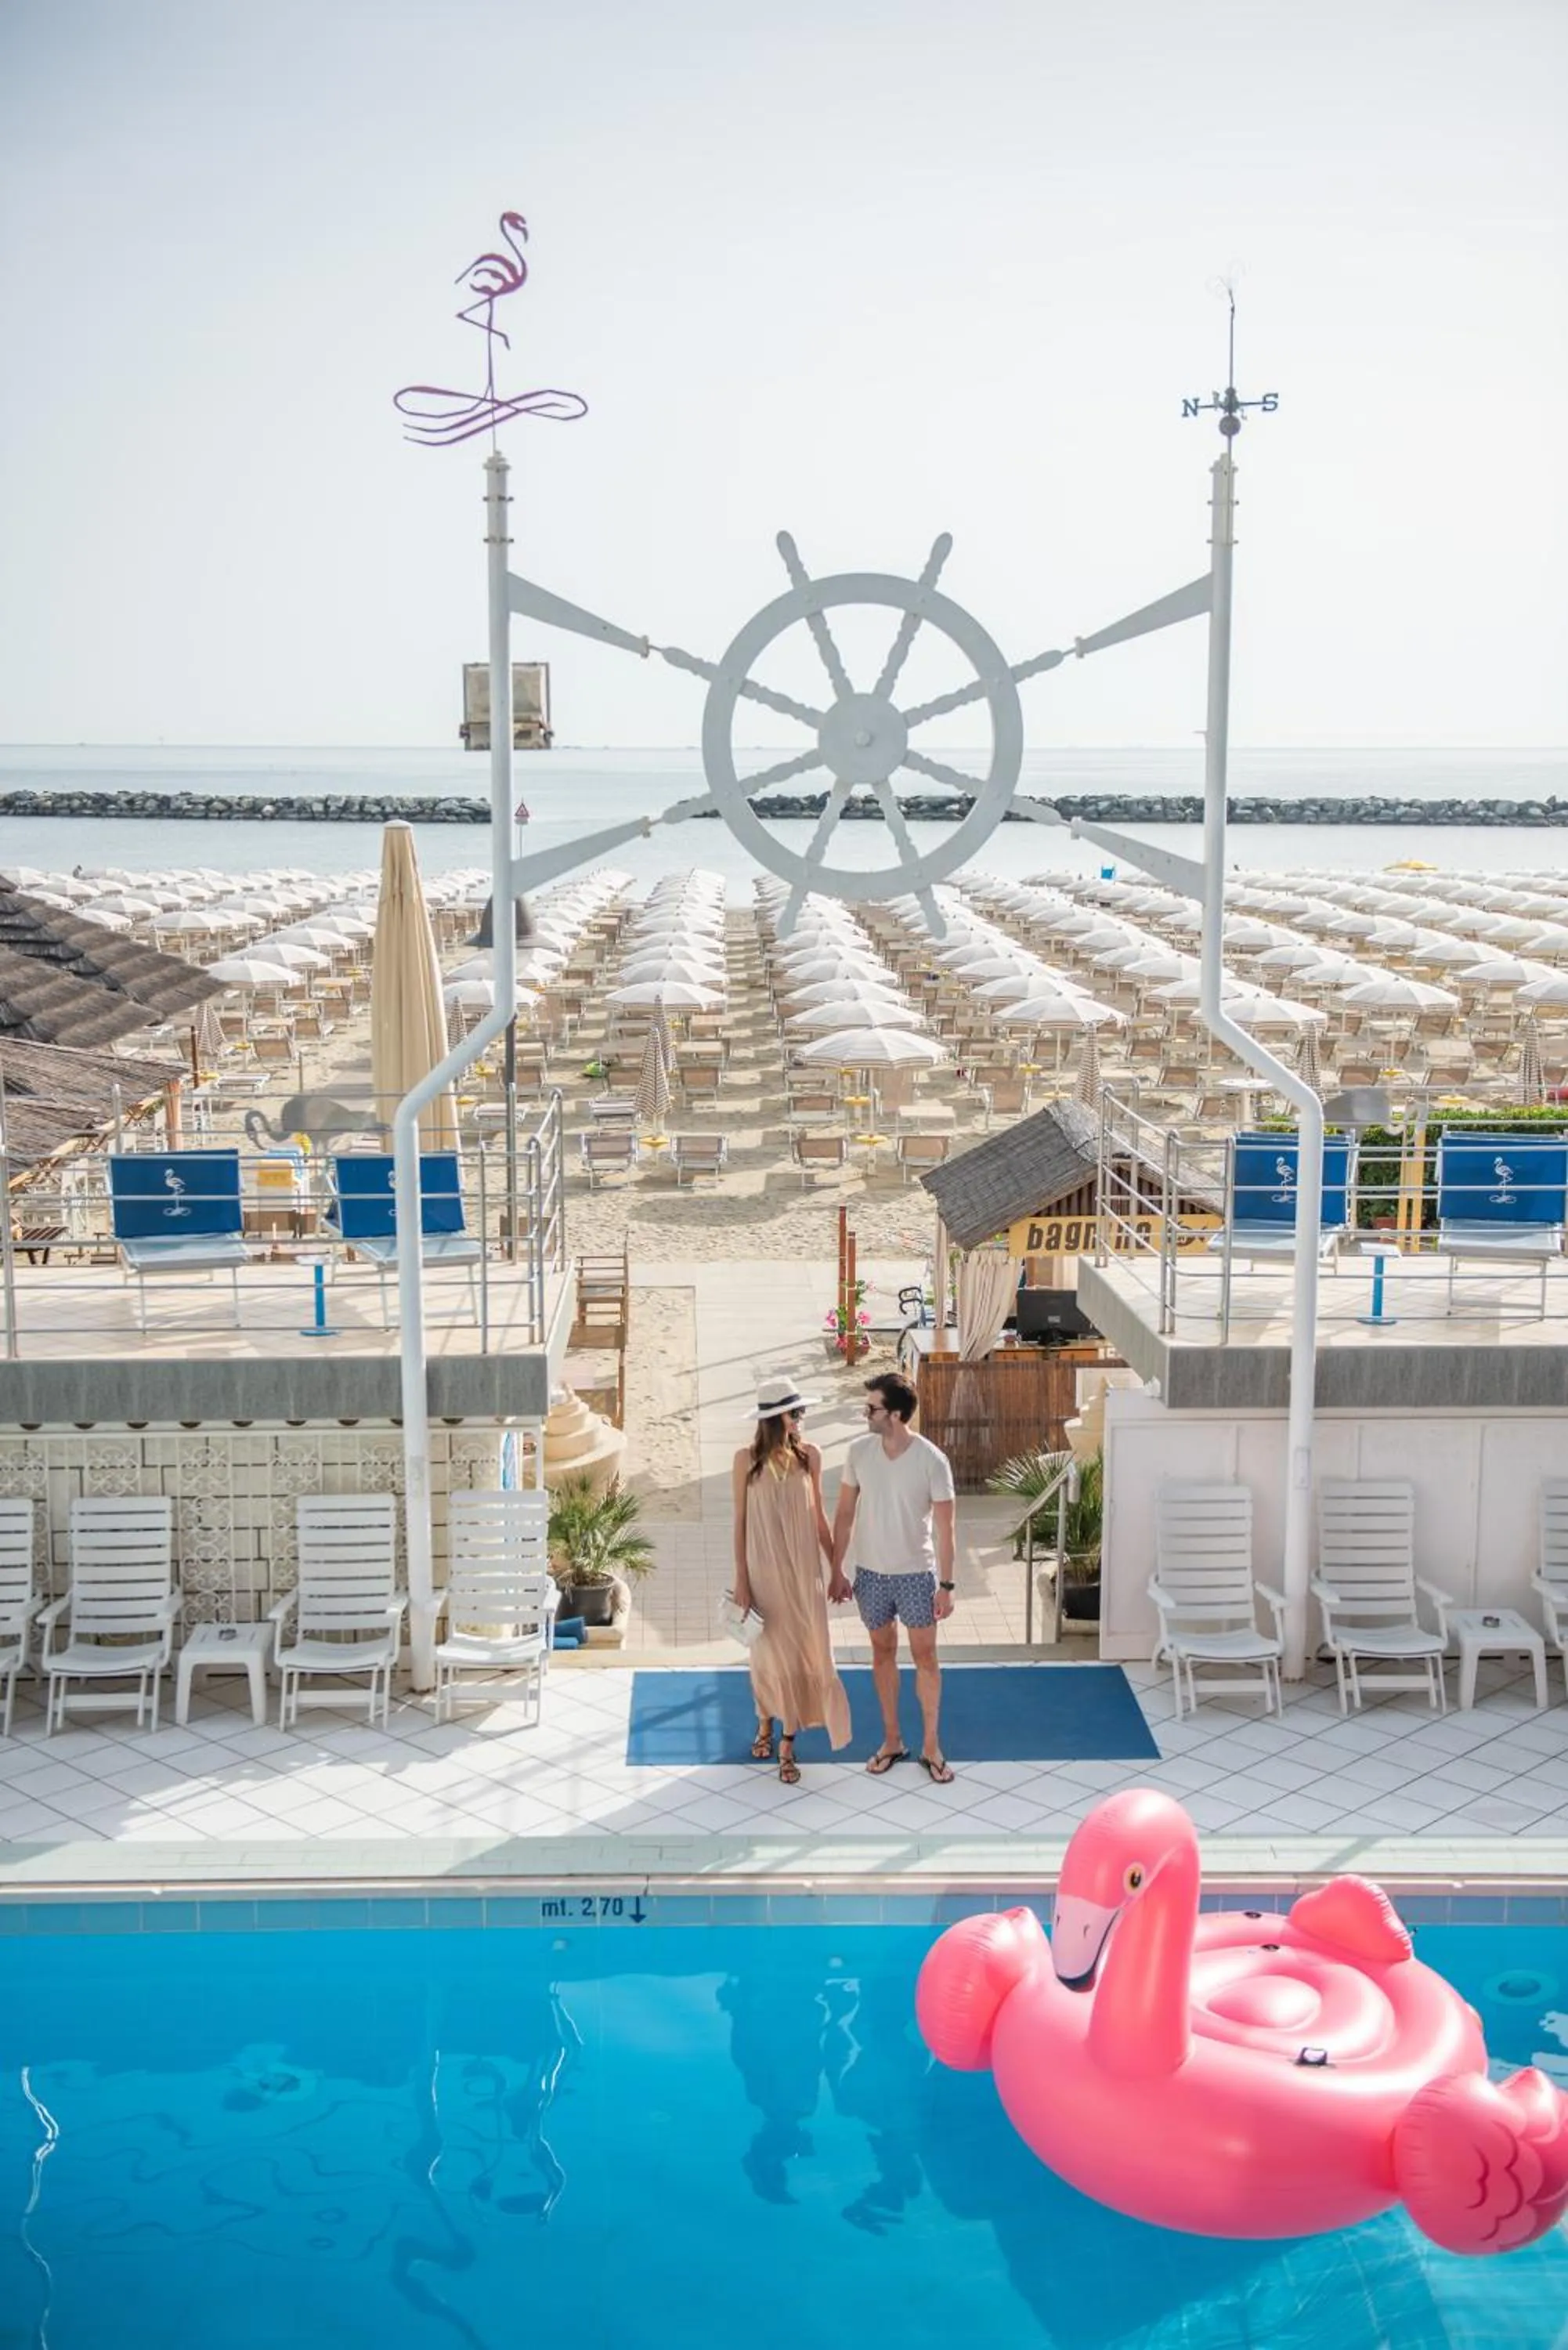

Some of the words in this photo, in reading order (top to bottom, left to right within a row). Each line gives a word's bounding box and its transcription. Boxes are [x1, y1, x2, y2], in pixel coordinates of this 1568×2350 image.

[1182, 398, 1199, 417] N
[1262, 393, 1279, 411] S
[1027, 1221, 1151, 1251] bagnno
[542, 1898, 573, 1917] mt.
